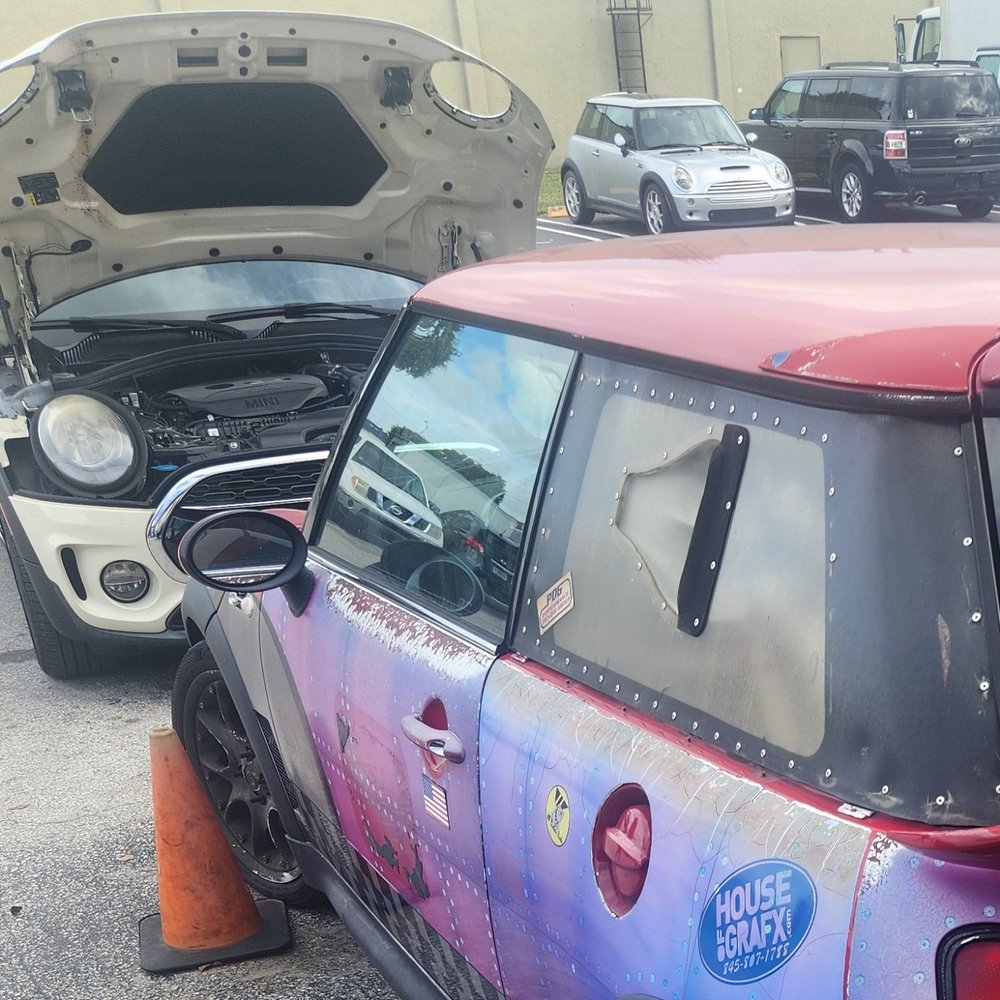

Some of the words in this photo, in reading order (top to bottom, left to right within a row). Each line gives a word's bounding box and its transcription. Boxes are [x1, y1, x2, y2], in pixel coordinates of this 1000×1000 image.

[245, 395, 280, 410] MINI
[716, 869, 792, 928] HOUSE
[725, 906, 788, 960] GRAFX
